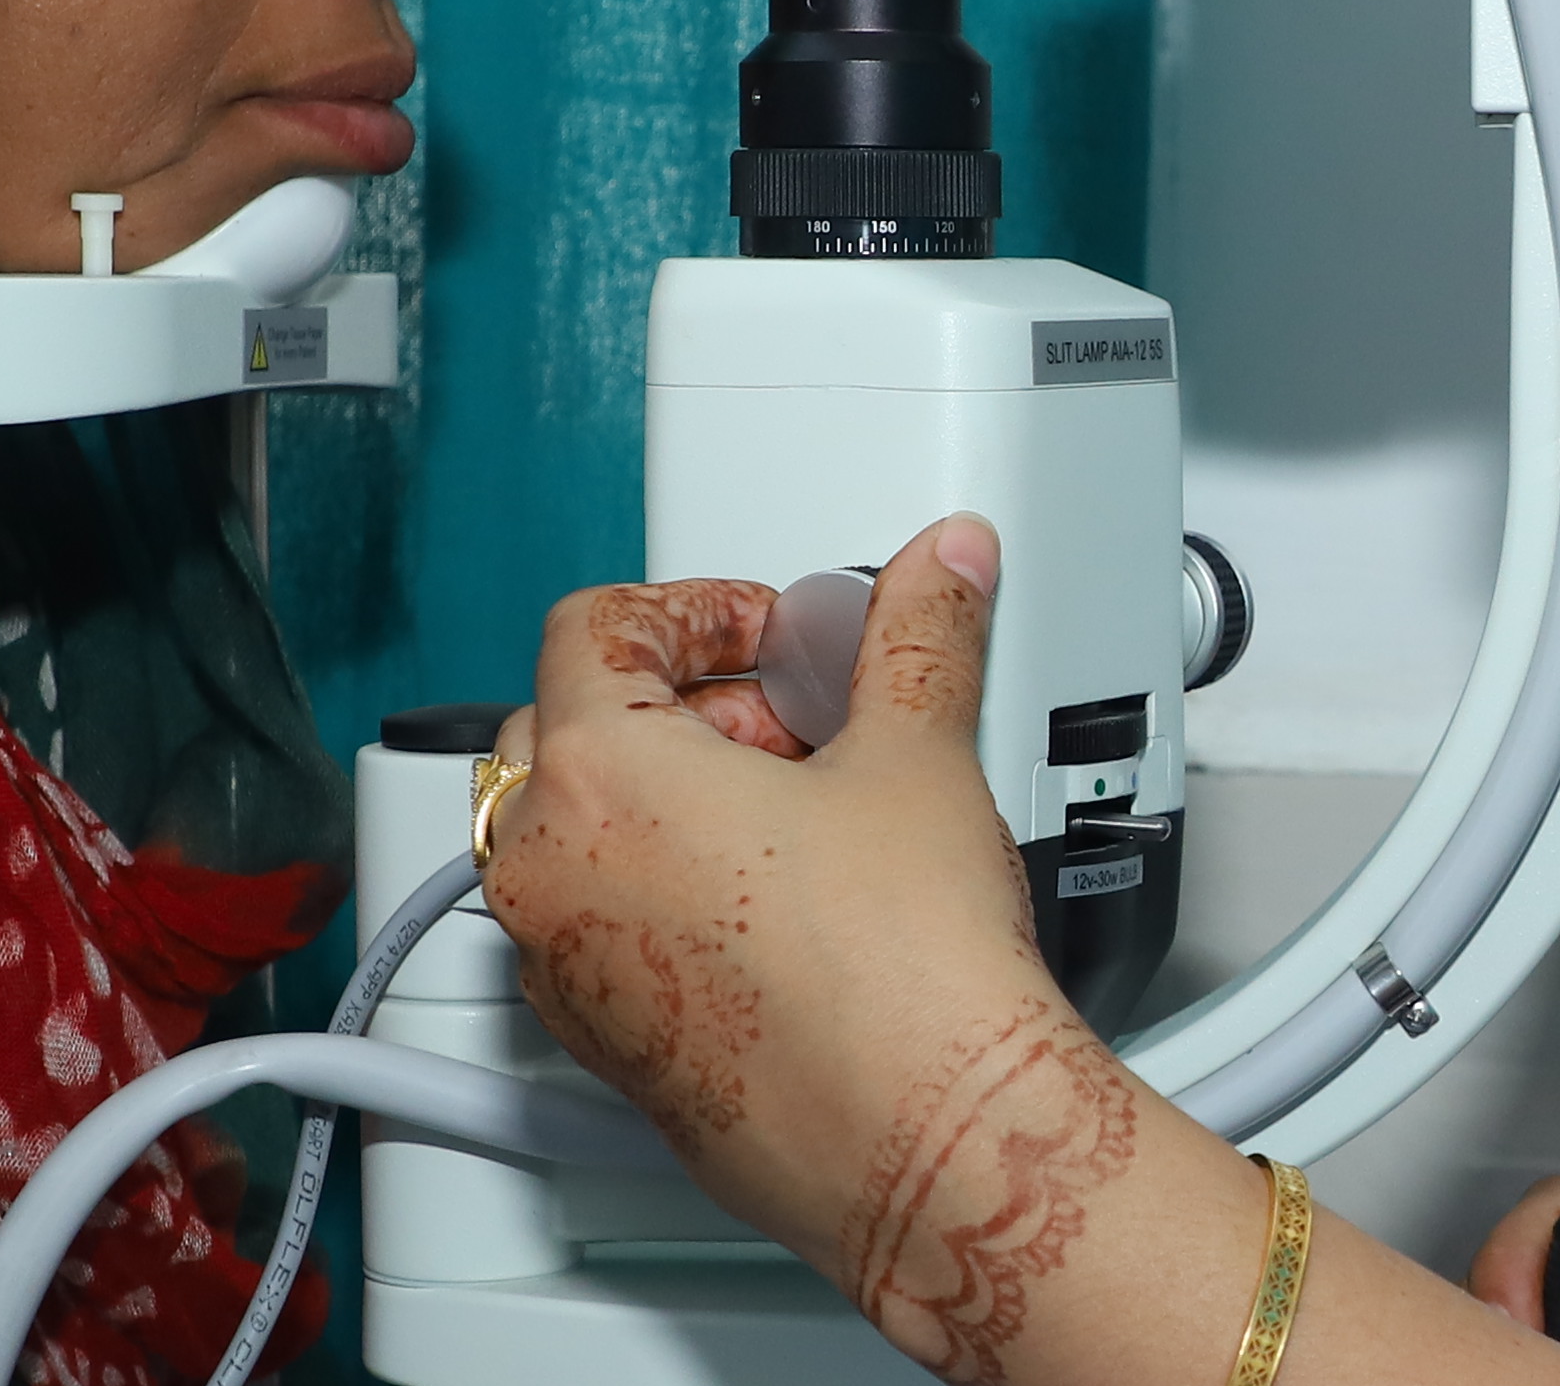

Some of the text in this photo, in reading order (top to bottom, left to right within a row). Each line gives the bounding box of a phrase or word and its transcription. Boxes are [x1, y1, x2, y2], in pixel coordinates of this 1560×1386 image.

[806, 220, 955, 234] 180 150 120
[1046, 341, 1072, 365] SLIT
[1075, 340, 1109, 363] LAMP
[1073, 863, 1138, 890] 12v-30w BULB
[361, 959, 392, 1001] LAPP
[333, 998, 364, 1036] KAB
[305, 1109, 328, 1162] GART
